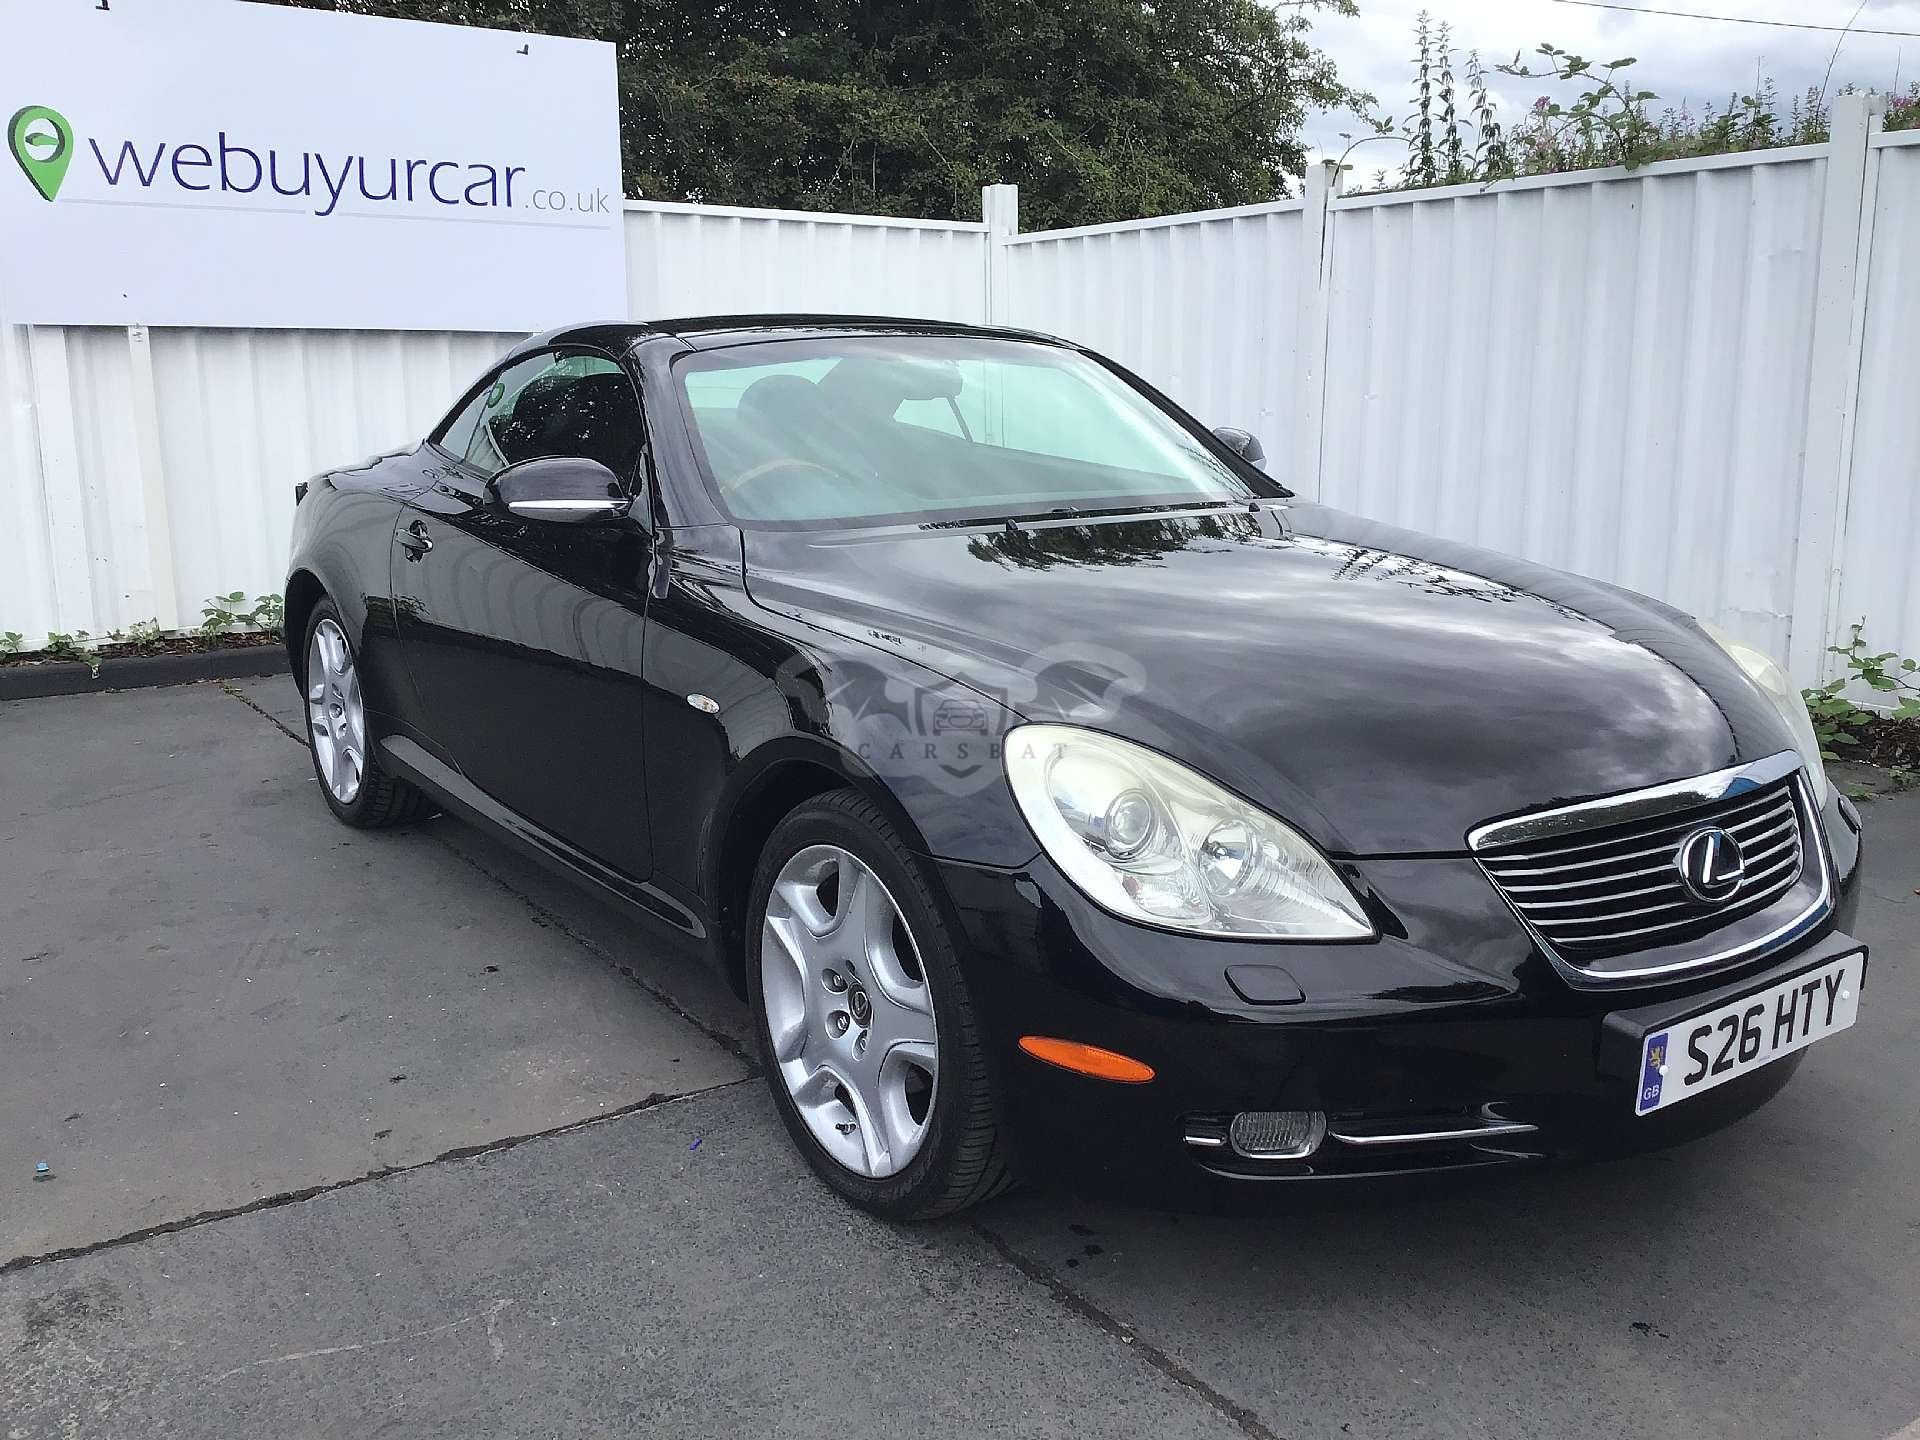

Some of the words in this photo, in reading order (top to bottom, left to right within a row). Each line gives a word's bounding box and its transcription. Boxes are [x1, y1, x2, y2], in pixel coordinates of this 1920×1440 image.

[1684, 1003, 1765, 1086] S26
[1771, 968, 1846, 1050] HTY
[1643, 1084, 1660, 1101] GB
